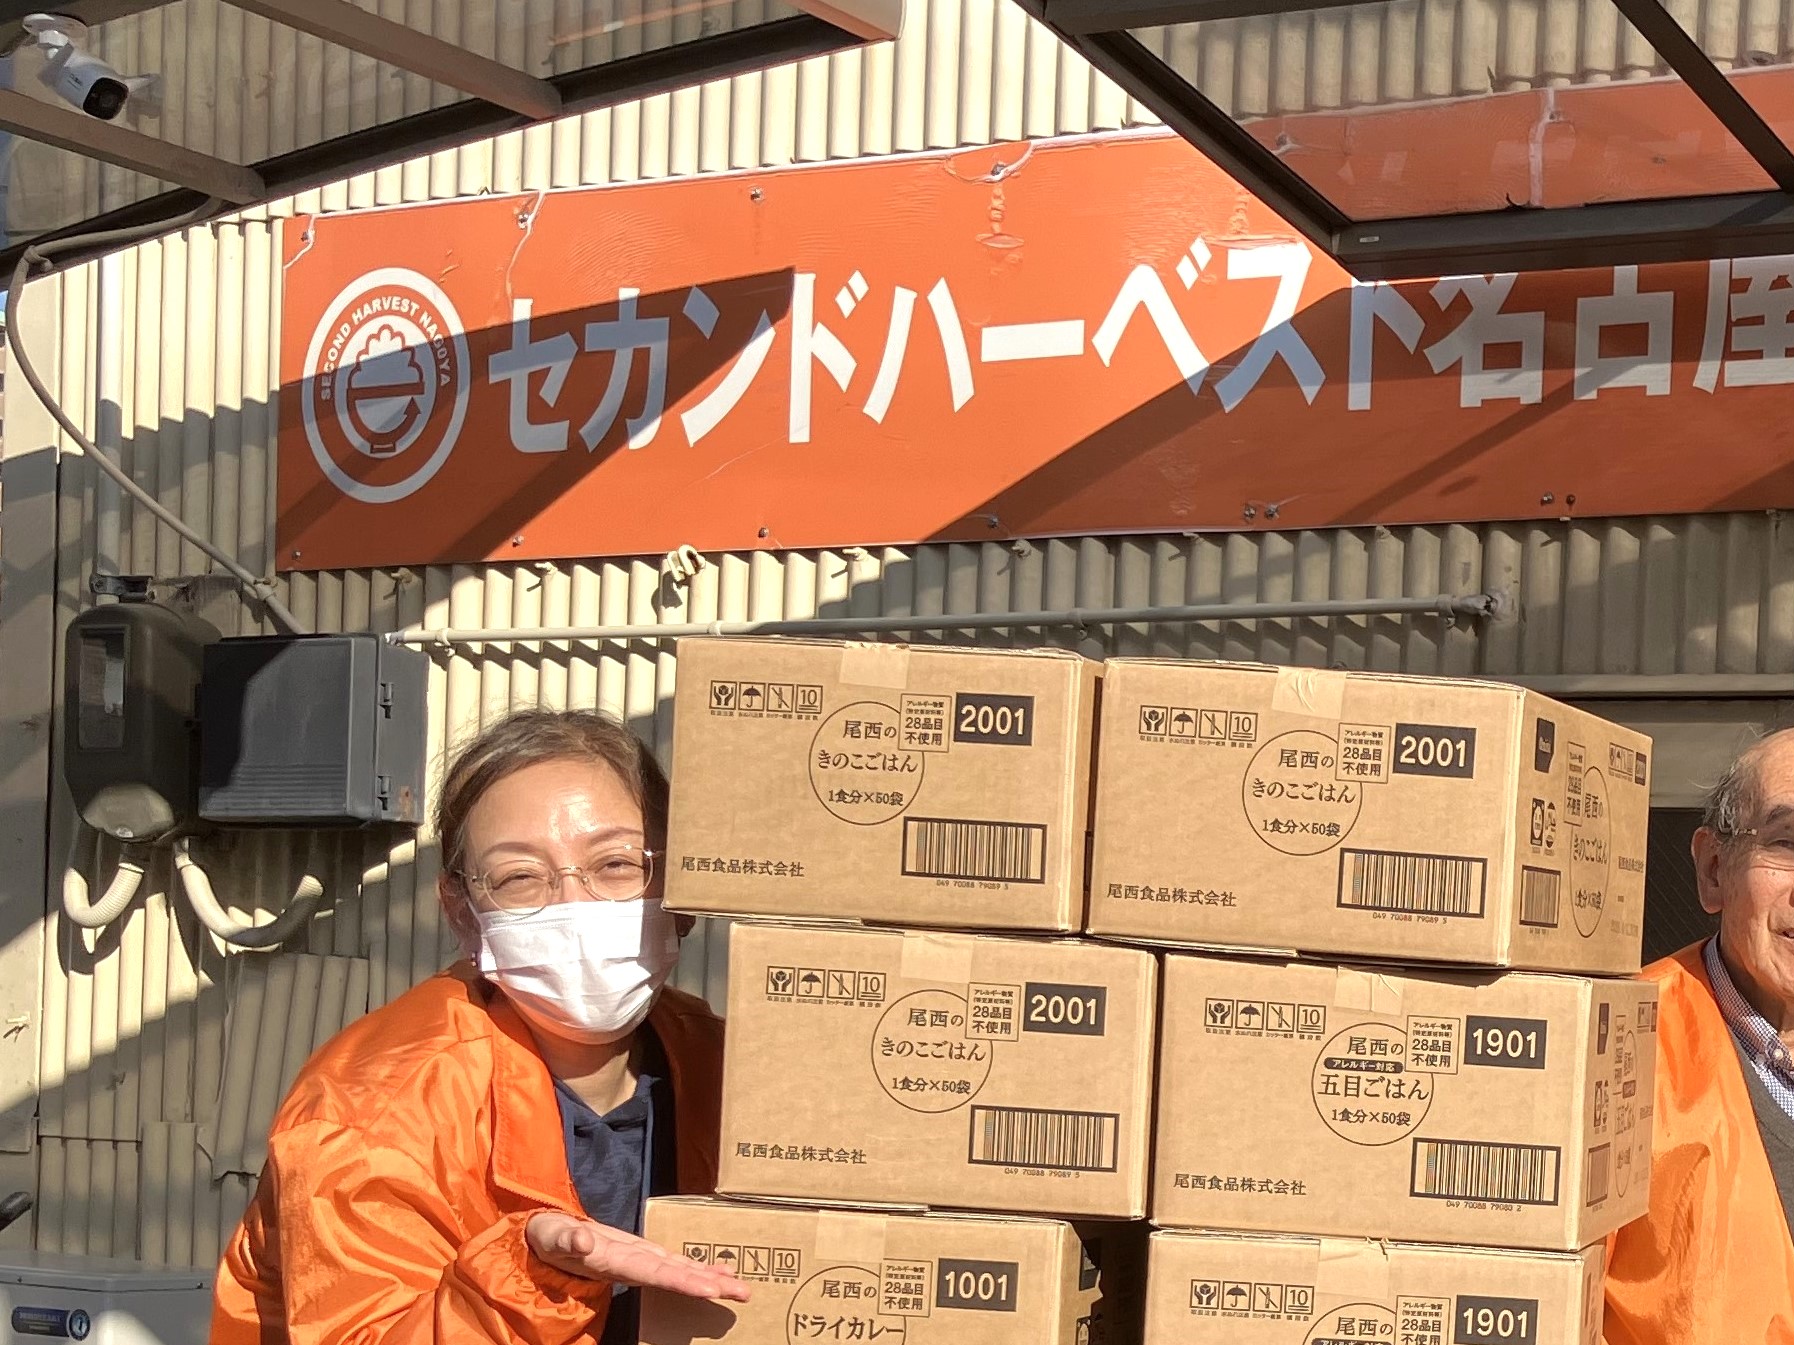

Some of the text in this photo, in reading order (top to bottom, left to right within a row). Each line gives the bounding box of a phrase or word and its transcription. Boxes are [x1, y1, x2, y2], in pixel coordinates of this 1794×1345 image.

[321, 296, 451, 400] SECOND HARVEST NAGOYA
[800, 689, 818, 706] 10
[843, 720, 897, 740] 尾西の
[905, 717, 943, 730] 28品目
[959, 704, 1025, 735] 2001
[1233, 716, 1253, 734] 10
[904, 731, 942, 746] 不使用
[817, 749, 918, 773] きのこごはん
[1278, 748, 1334, 770] 尾西の
[1342, 746, 1382, 761] 28品目
[1399, 735, 1467, 767] 2001
[1341, 761, 1381, 777] 不使用
[1250, 778, 1356, 803] きのこごはん
[680, 855, 804, 877] 尾西食品株式会社
[1106, 883, 1237, 906] 尾西食品株式会社
[862, 976, 881, 993] 10
[907, 1008, 964, 1029] 尾西の
[972, 1005, 1012, 1019] 28品目
[1029, 993, 1097, 1025] 2001
[1301, 1009, 1320, 1026] 10
[971, 1020, 1011, 1035] 不使用
[880, 1037, 986, 1061] きのこごはん
[1347, 1036, 1404, 1058] 尾西の
[1412, 1038, 1451, 1052] 28品目
[1471, 1027, 1537, 1058] 1901
[1331, 1059, 1395, 1072] アレルギー対応
[1411, 1053, 1451, 1068] 不使用
[1317, 1072, 1430, 1101] 五目ごはん
[735, 1141, 867, 1164] 尾西食品株式会社
[1173, 1172, 1307, 1195] 尾西食品株式会社
[776, 1253, 795, 1269] 10
[820, 1279, 877, 1300] 尾西の
[884, 1281, 923, 1295] 28品目
[944, 1270, 1008, 1302] 1001
[884, 1296, 923, 1310] 不使用
[1289, 1290, 1308, 1307] 10
[791, 1312, 904, 1343] ドライカレー
[1335, 1316, 1393, 1338] 尾西の
[1401, 1318, 1441, 1332] 28品目
[1461, 1307, 1528, 1338] 1901
